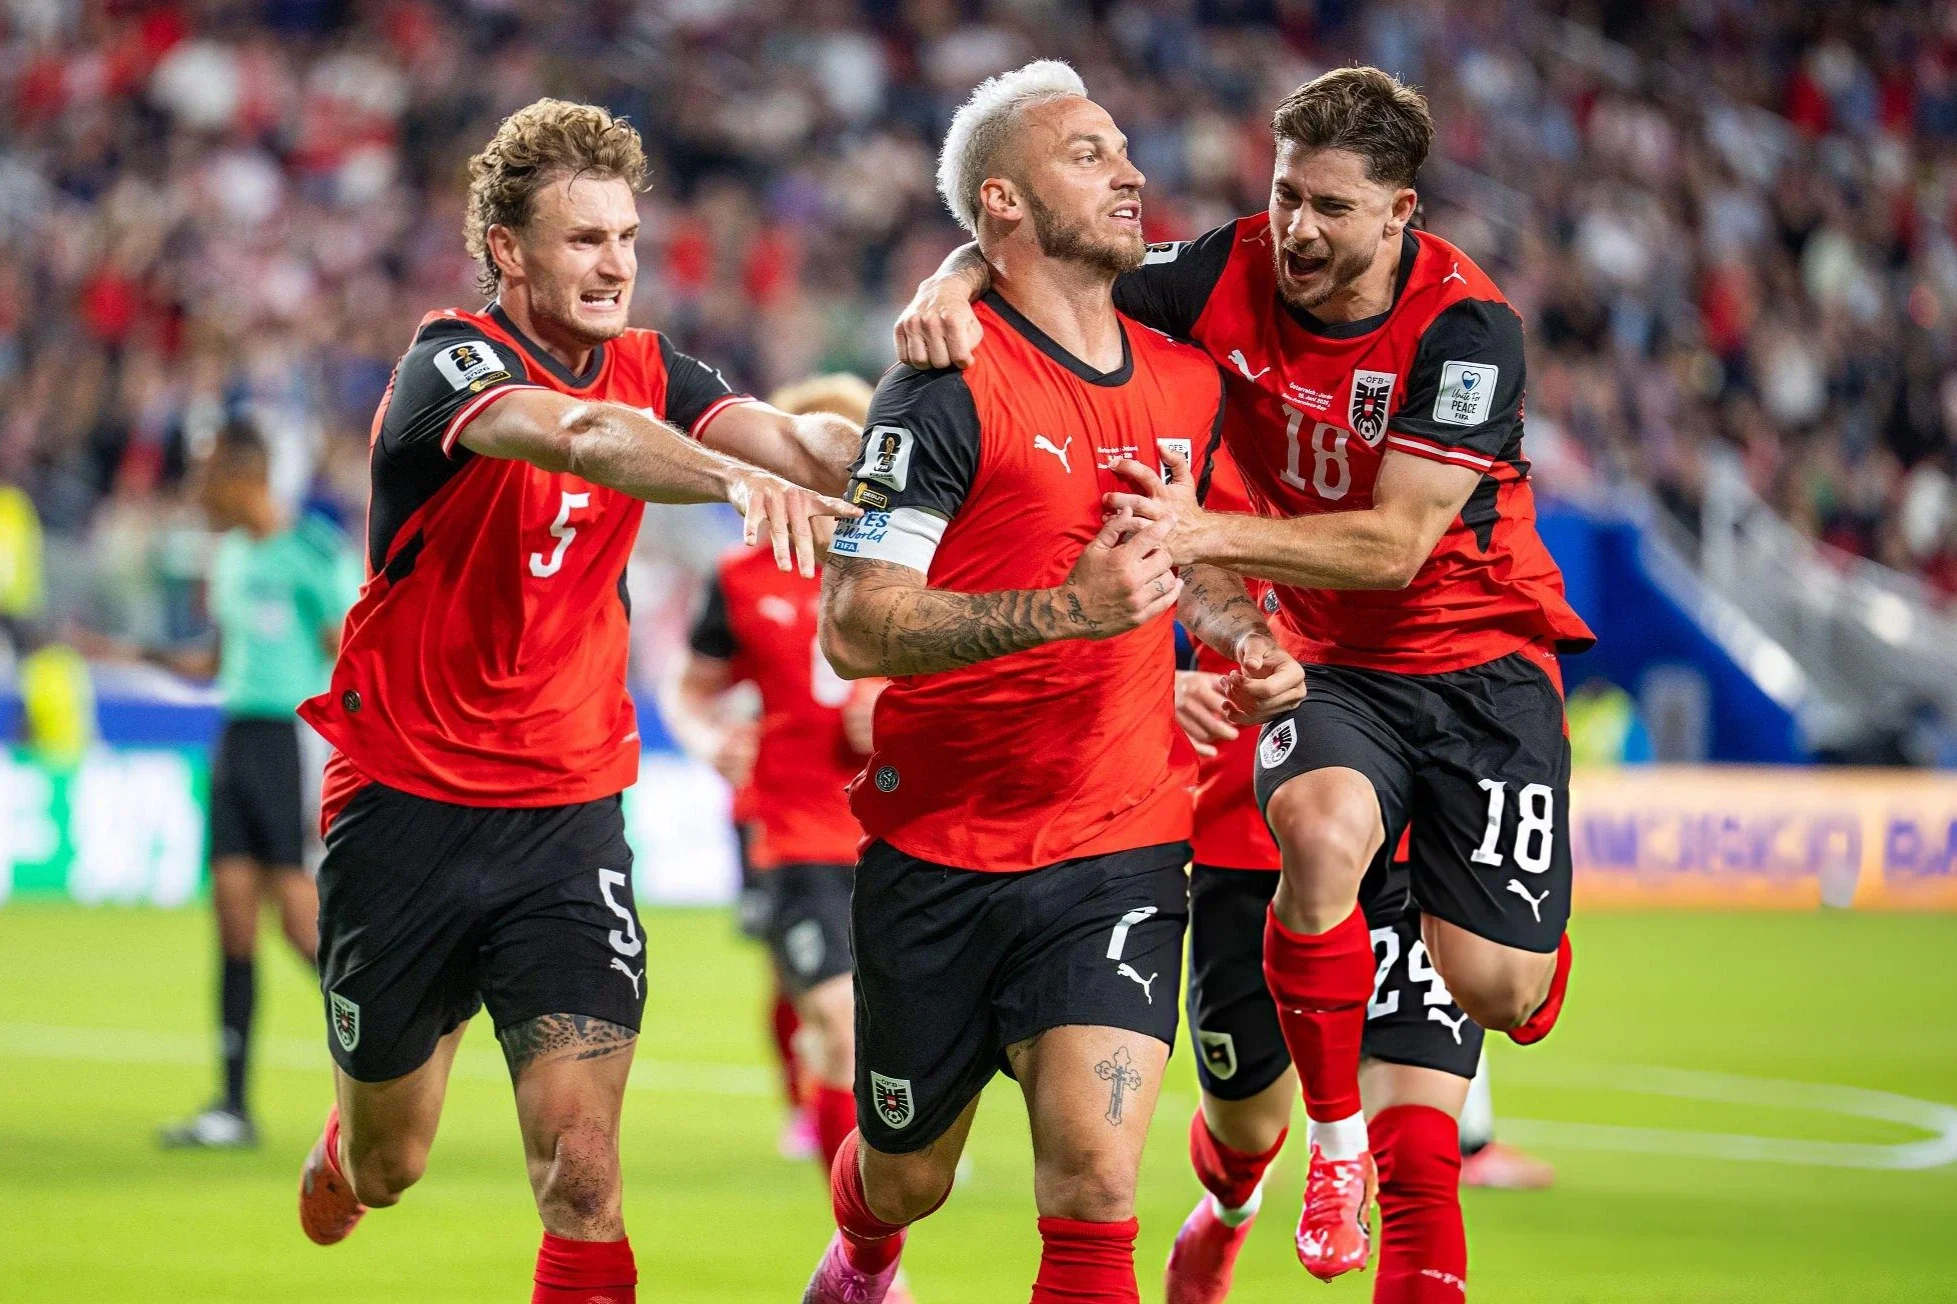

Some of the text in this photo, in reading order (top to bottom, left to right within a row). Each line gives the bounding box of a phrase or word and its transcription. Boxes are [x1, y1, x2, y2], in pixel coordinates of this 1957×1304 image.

[1451, 400, 1477, 413] PEACE
[1452, 389, 1481, 402] Unite For
[1280, 403, 1351, 500] 18
[863, 491, 884, 502] DEBUT
[528, 491, 591, 578] 5
[835, 541, 856, 551] FIFA
[843, 526, 888, 543] World
[1470, 778, 1553, 873] 18
[598, 868, 642, 957] 5
[1106, 906, 1158, 960] 7
[1367, 926, 1453, 1020] 24
